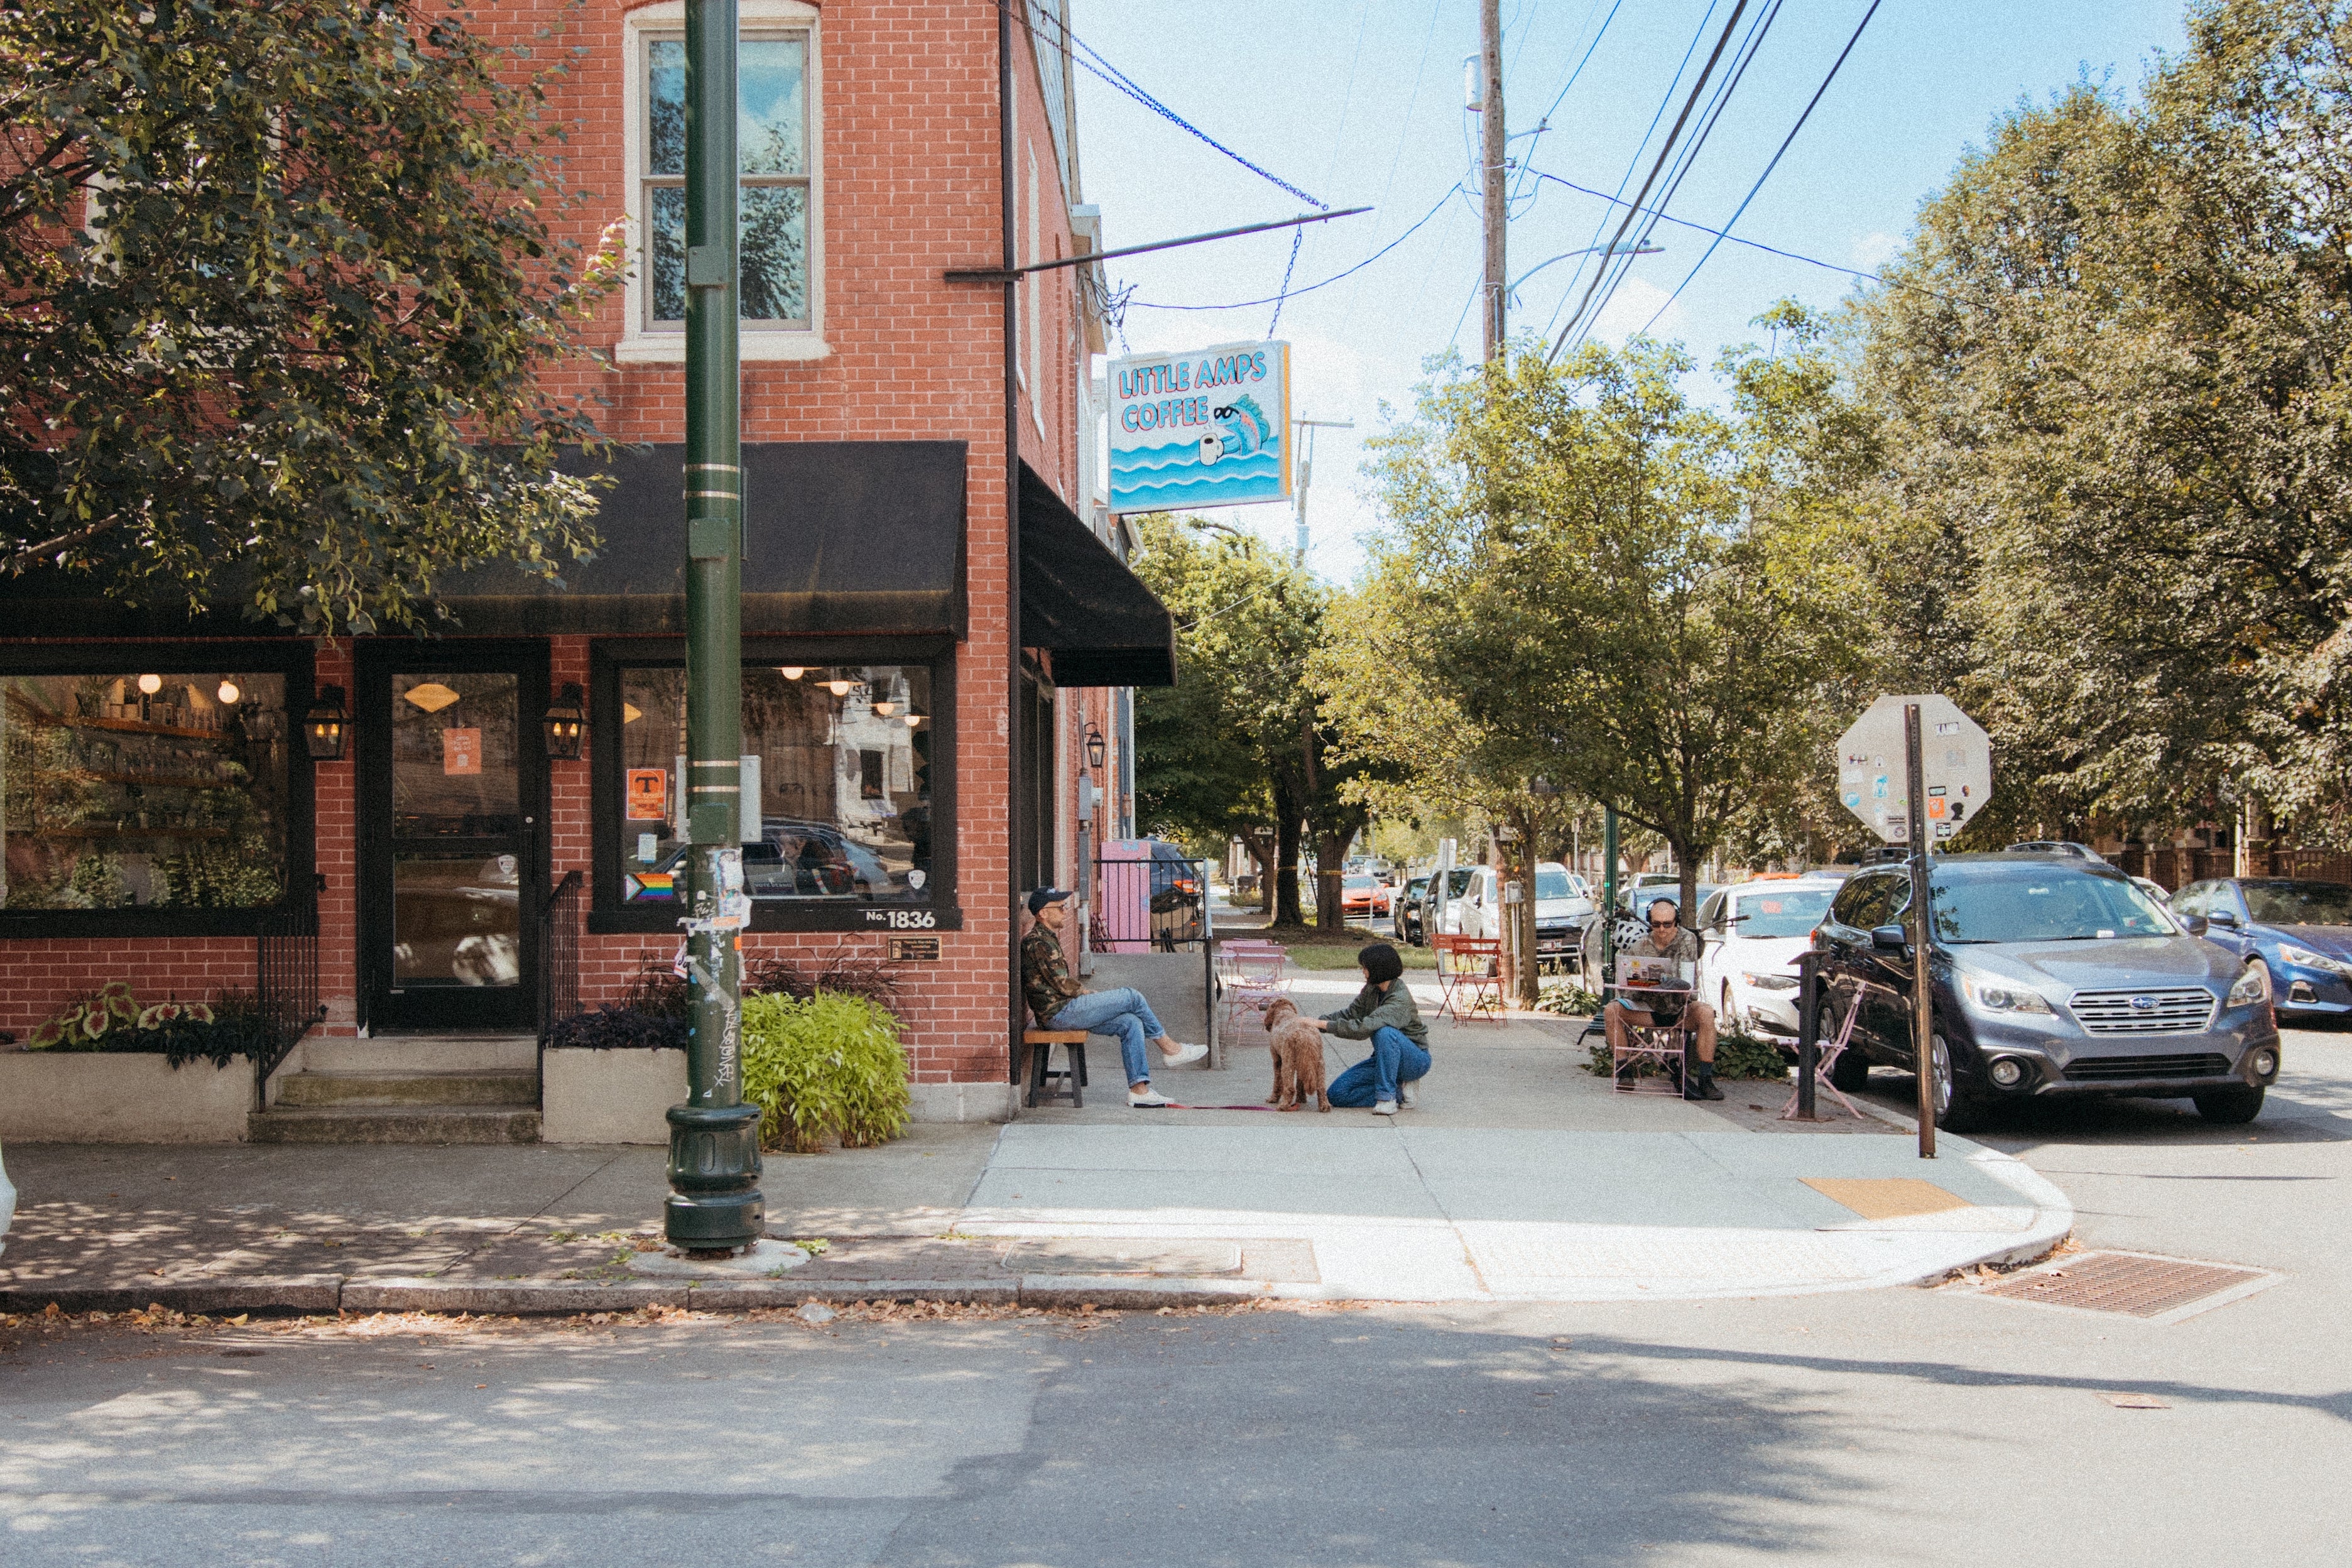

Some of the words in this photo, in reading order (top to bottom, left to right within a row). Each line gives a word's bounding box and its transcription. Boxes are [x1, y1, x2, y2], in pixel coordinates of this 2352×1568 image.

[1119, 361, 1190, 399] LITTLE
[1195, 351, 1267, 388] AMPS
[1122, 396, 1209, 432] COFFEE
[635, 776, 659, 793] T
[866, 912, 886, 921] No.
[887, 911, 936, 928] 1836
